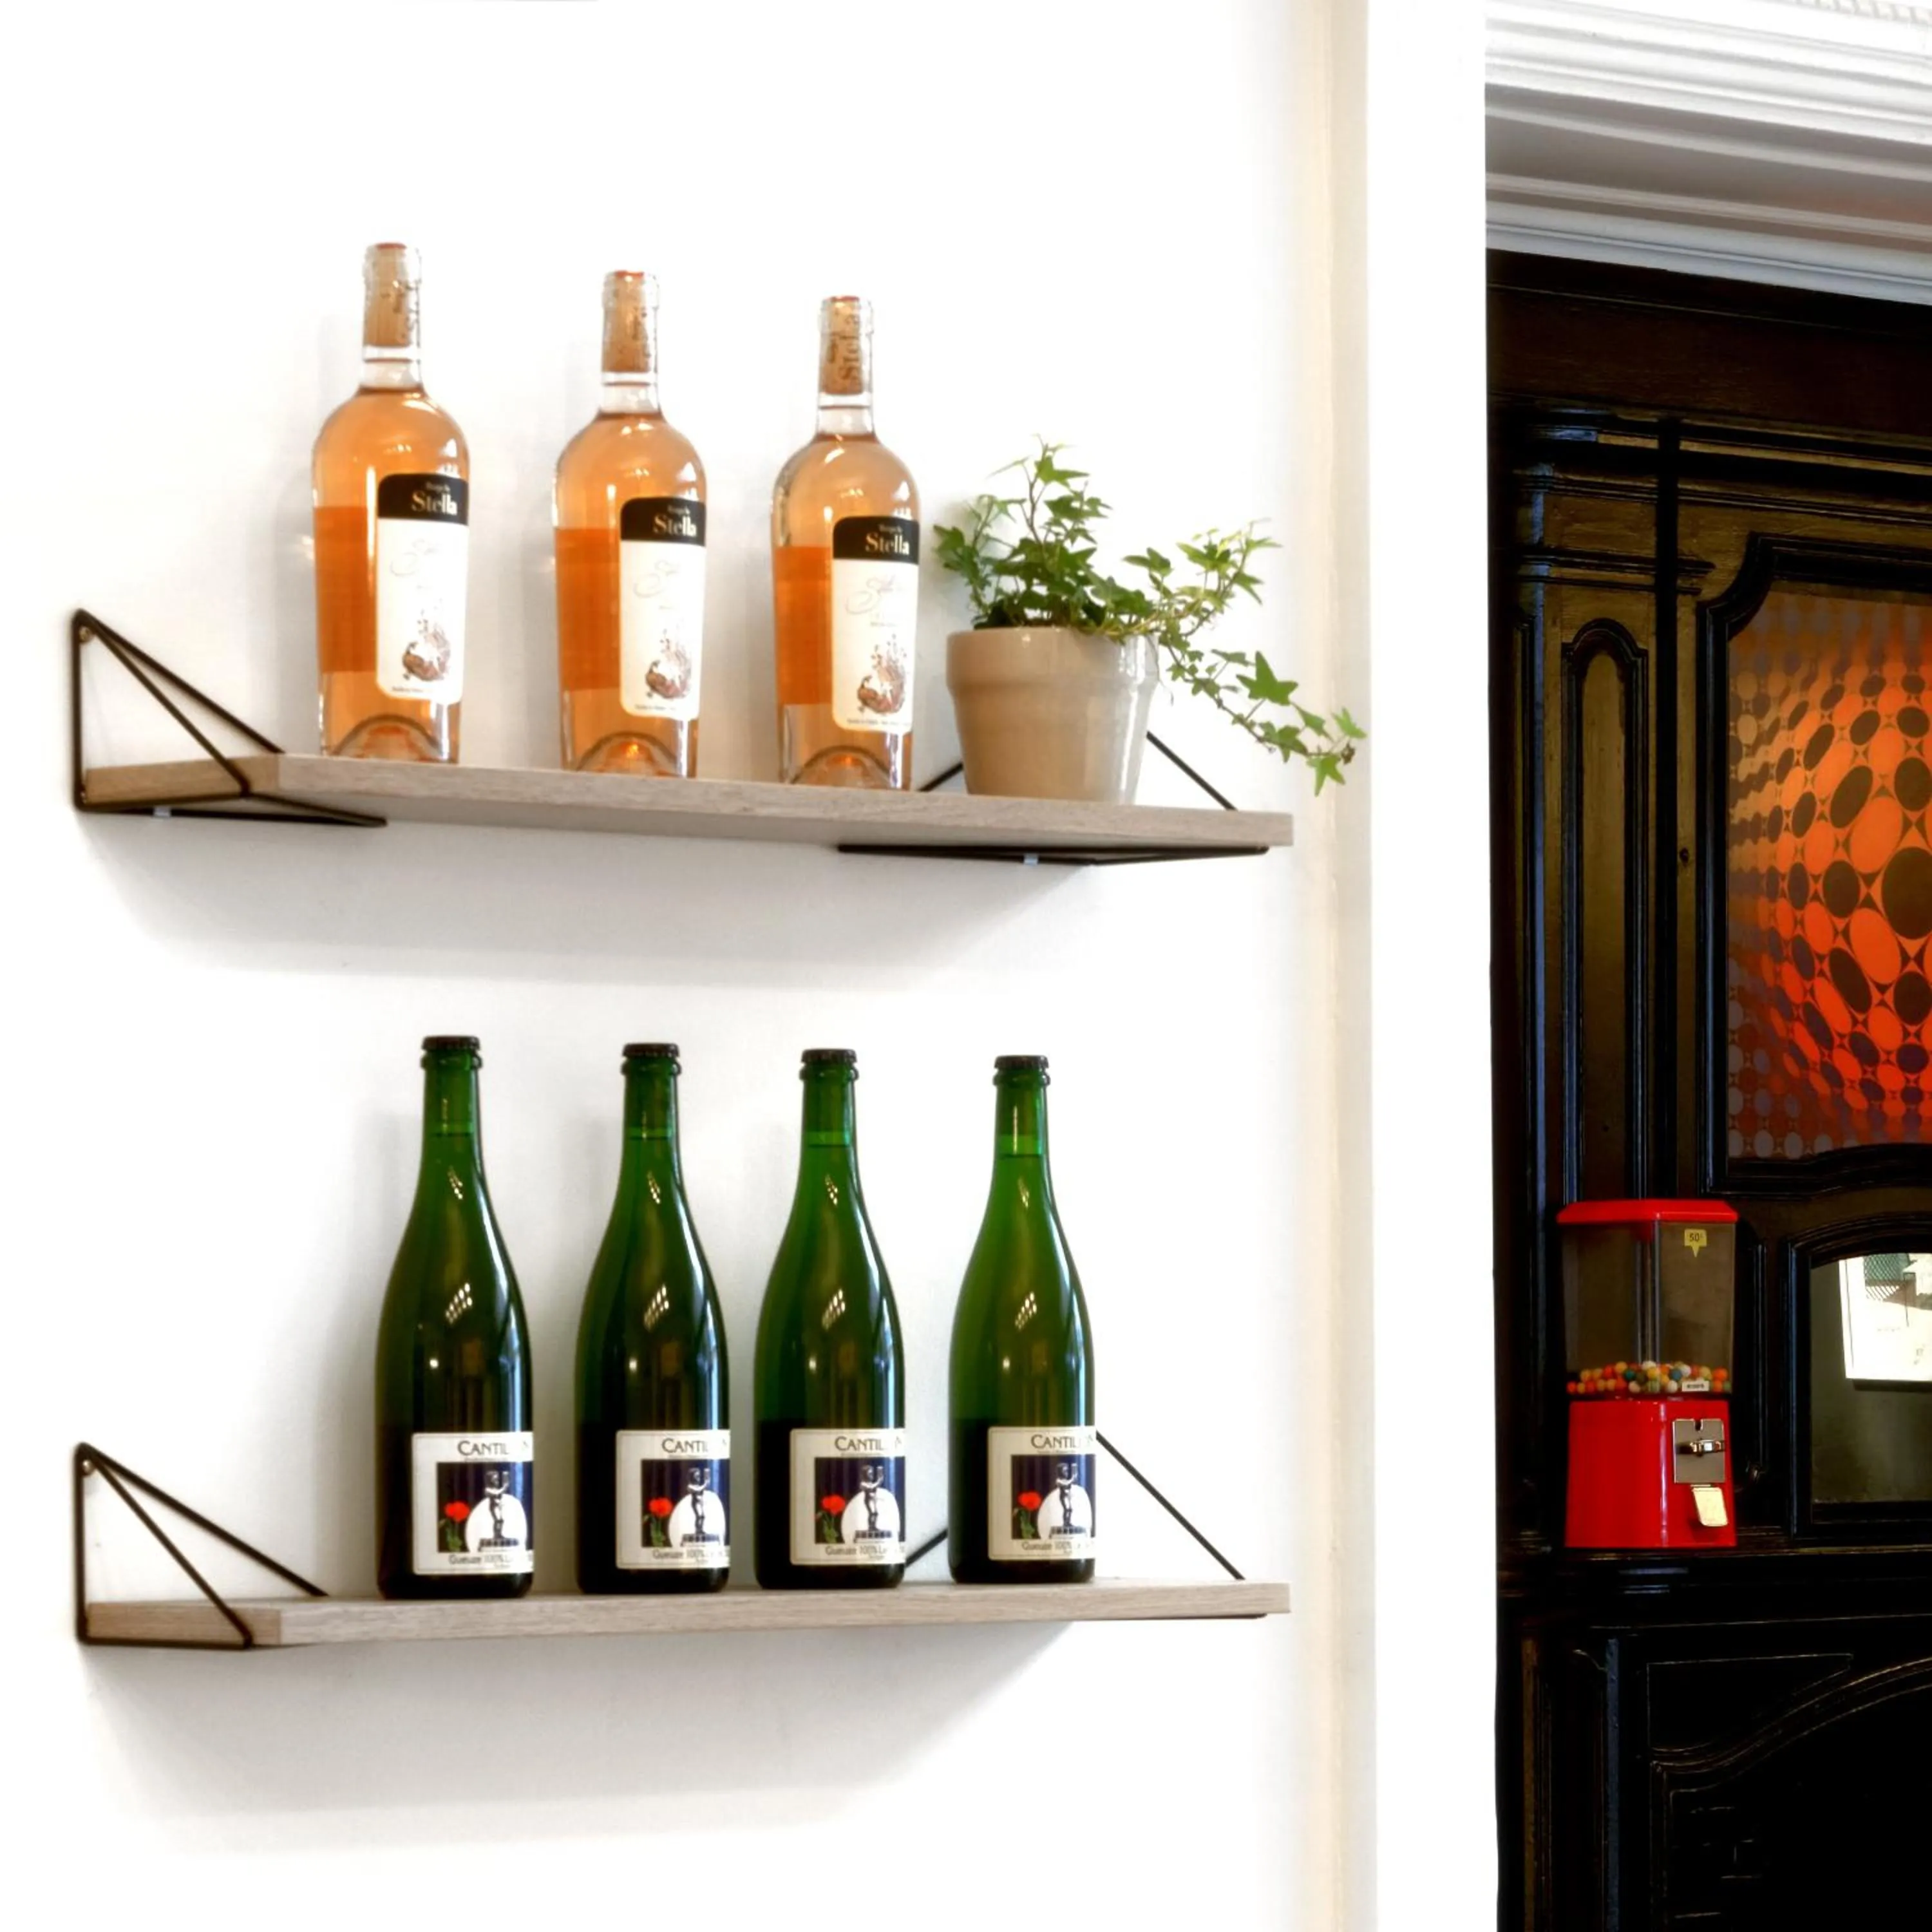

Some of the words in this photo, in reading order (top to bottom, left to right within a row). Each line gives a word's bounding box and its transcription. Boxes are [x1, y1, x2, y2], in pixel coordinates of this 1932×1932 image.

[411, 490, 458, 516] Stella
[653, 514, 697, 537] Stella
[865, 532, 910, 555] Stella
